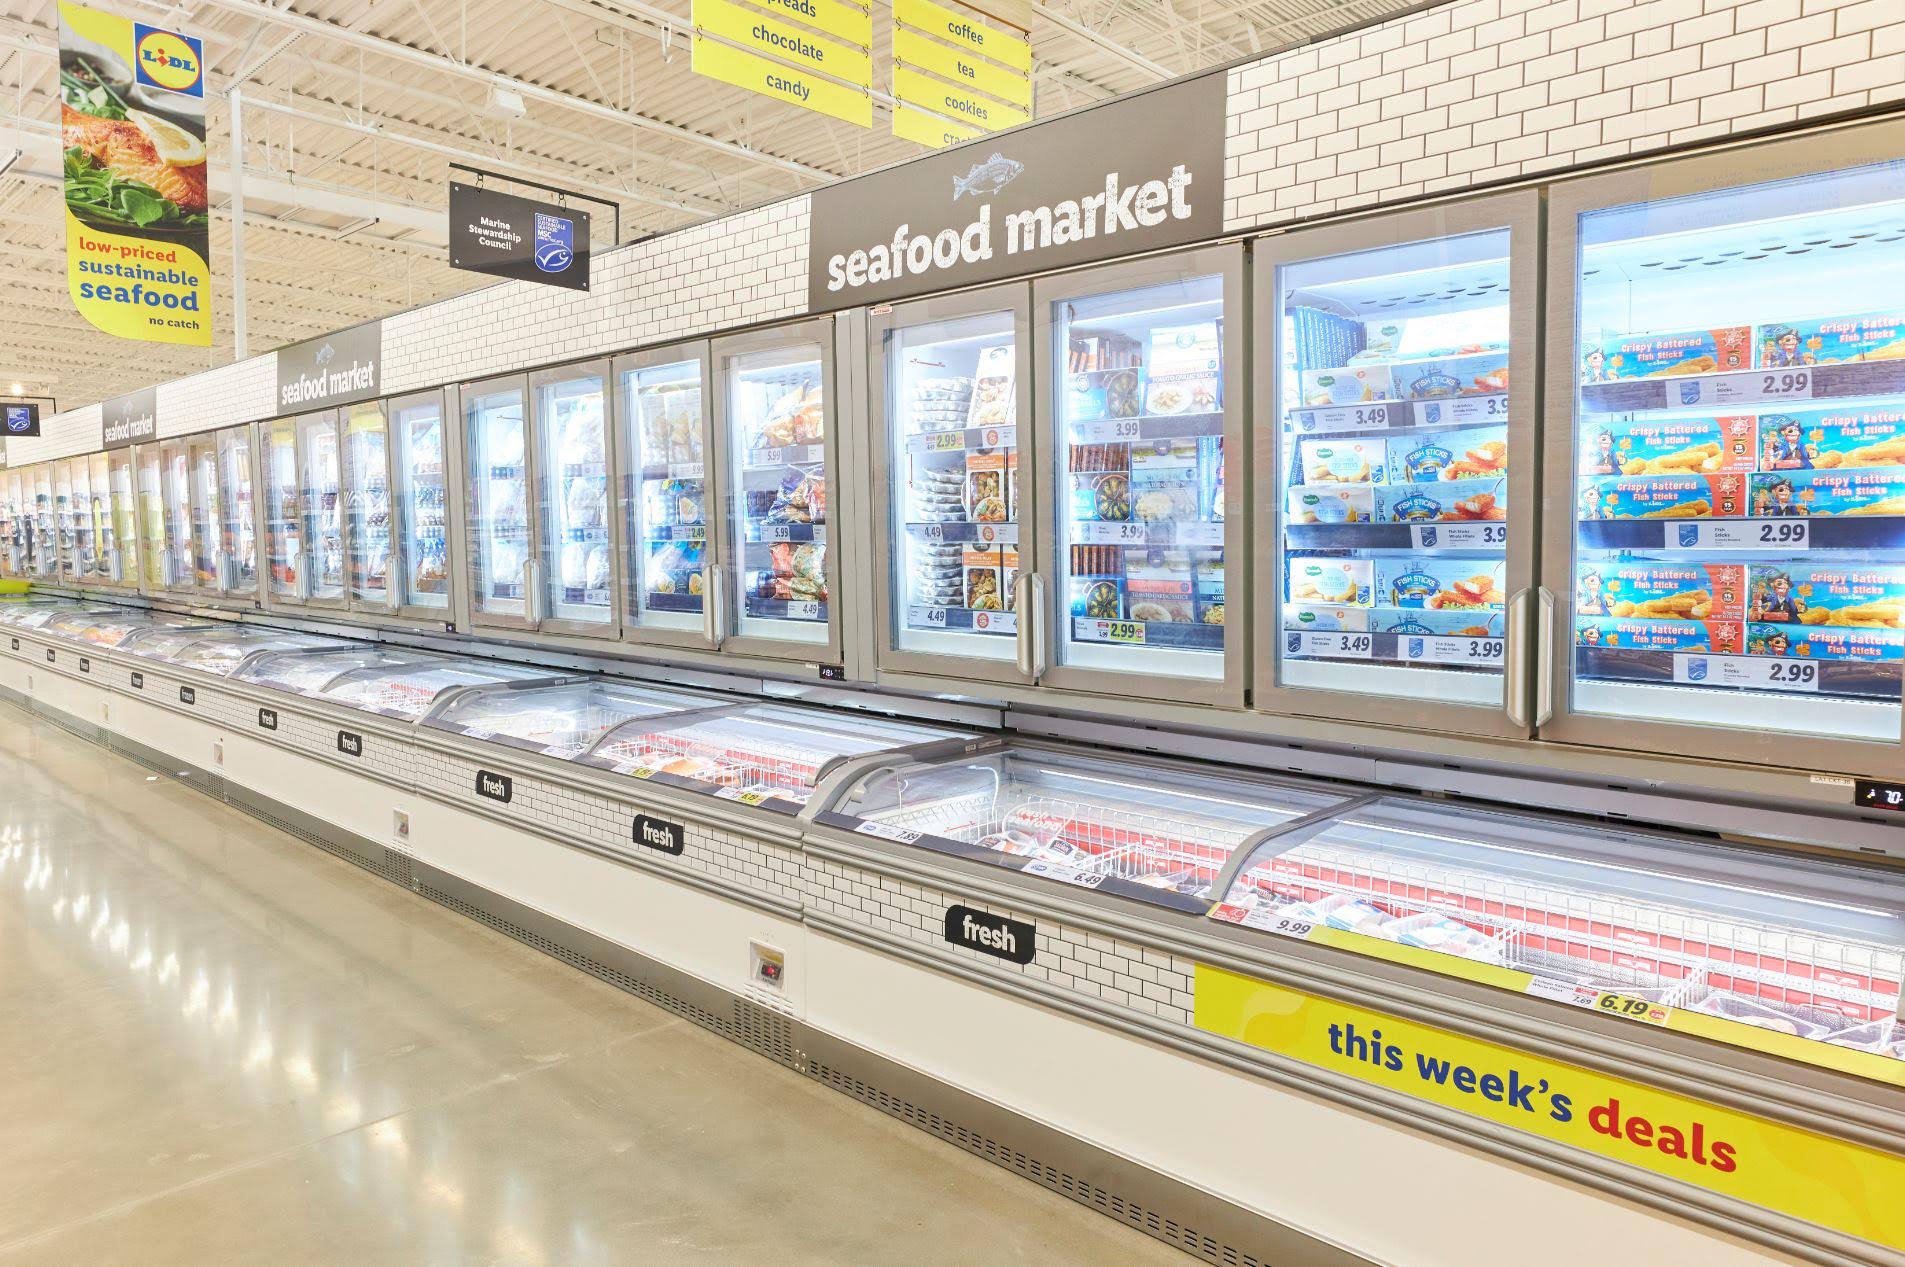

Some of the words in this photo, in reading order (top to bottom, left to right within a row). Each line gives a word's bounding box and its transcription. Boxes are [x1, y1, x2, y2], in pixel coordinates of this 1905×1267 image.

[948, 21, 984, 45] coffee
[752, 24, 824, 62] chocolate
[957, 60, 975, 79] tea
[766, 73, 810, 101] candy
[945, 94, 988, 120] cookies
[480, 216, 511, 230] Marine
[827, 204, 993, 292] seafood
[1005, 164, 1192, 254] market
[468, 224, 521, 243] Stewardship
[537, 229, 552, 239] MSC
[79, 236, 176, 264] low-priced
[479, 237, 512, 251] Council
[79, 259, 199, 288] sustainable
[80, 282, 199, 312] seafood
[149, 317, 165, 328] no
[167, 318, 200, 330] catch
[1820, 322, 1858, 334] Crispy
[1840, 333, 1860, 343] Fish
[1864, 330, 1896, 340] Sticks
[1621, 343, 1652, 354] Crispy
[1656, 337, 1703, 349] Battered
[1638, 353, 1654, 362] Fish
[1658, 351, 1683, 360] Sticks
[281, 369, 327, 406] seafood
[329, 360, 374, 394] market
[1414, 377, 1431, 390] FISH
[1431, 376, 1456, 386] STICKS
[1762, 372, 1808, 394] 2.99
[1487, 398, 1507, 415] 3.9
[1356, 408, 1385, 425] 3.49
[1821, 416, 1858, 427] Crispy
[105, 418, 129, 443] seafood
[130, 414, 153, 438] market
[1116, 422, 1138, 436] 3.99
[1630, 428, 1660, 437] Crispy
[1664, 425, 1709, 434] Battered
[1841, 427, 1861, 437] Fish
[1864, 425, 1896, 435] Sticks
[936, 433, 957, 448] 2.99
[1645, 437, 1662, 445] Fish
[1664, 436, 1691, 444] Sticks
[767, 450, 781, 461] 5.99
[1409, 450, 1425, 462] FISH
[1425, 448, 1448, 459] STICKS
[1617, 483, 1648, 492] Crispy
[1652, 481, 1697, 490] Battered
[1813, 477, 1850, 488] Crispy
[1633, 493, 1650, 501] Fish
[1653, 492, 1679, 500] Sticks
[1832, 488, 1852, 496] Fish
[1856, 486, 1888, 495] Sticks
[1398, 500, 1412, 512] FISH
[1413, 498, 1437, 510] STICKS
[692, 527, 705, 538] 2.49
[775, 526, 789, 538] 5.99
[924, 526, 941, 538] 4.49
[1121, 525, 1143, 539] 3.99
[1484, 526, 1506, 543] 3.9
[1760, 524, 1805, 542] 2.99
[1397, 575, 1413, 587] FISH
[1413, 575, 1436, 587] STICKS
[1618, 570, 1649, 580] Crispy
[1653, 570, 1697, 580] Battered
[1810, 573, 1847, 585] Crispy
[1634, 581, 1650, 589] Fish
[1653, 581, 1679, 589] Sticks
[1829, 585, 1850, 594] Fish
[1853, 585, 1884, 595] Sticks
[802, 603, 817, 615] 4.49
[927, 609, 945, 622] 4.49
[1111, 623, 1135, 638] 2.99
[1391, 624, 1406, 633] FISH
[1407, 624, 1430, 634] STICKS
[1617, 624, 1648, 634] Crispy
[1651, 626, 1696, 635] Battered
[1340, 635, 1370, 652] 3.49
[1632, 635, 1649, 644] Fish
[1652, 636, 1677, 645] Sticks
[1808, 632, 1846, 645] Crispy
[1468, 640, 1503, 658] 3.99
[1827, 645, 1847, 654] Fish
[1850, 646, 1882, 656] Sticks
[1769, 662, 1815, 683] 2.99
[262, 711, 274, 726] fresh
[342, 735, 358, 752] fresh
[483, 774, 505, 798] fresh
[642, 822, 674, 848] fresh
[1074, 872, 1101, 885] 6.49
[962, 914, 1016, 953] fresh
[1277, 919, 1311, 934] 9.99
[1600, 994, 1648, 1015] 6.19
[1328, 1021, 1403, 1073] this
[1416, 1052, 1573, 1124] week's
[1588, 1098, 1738, 1174] deals
